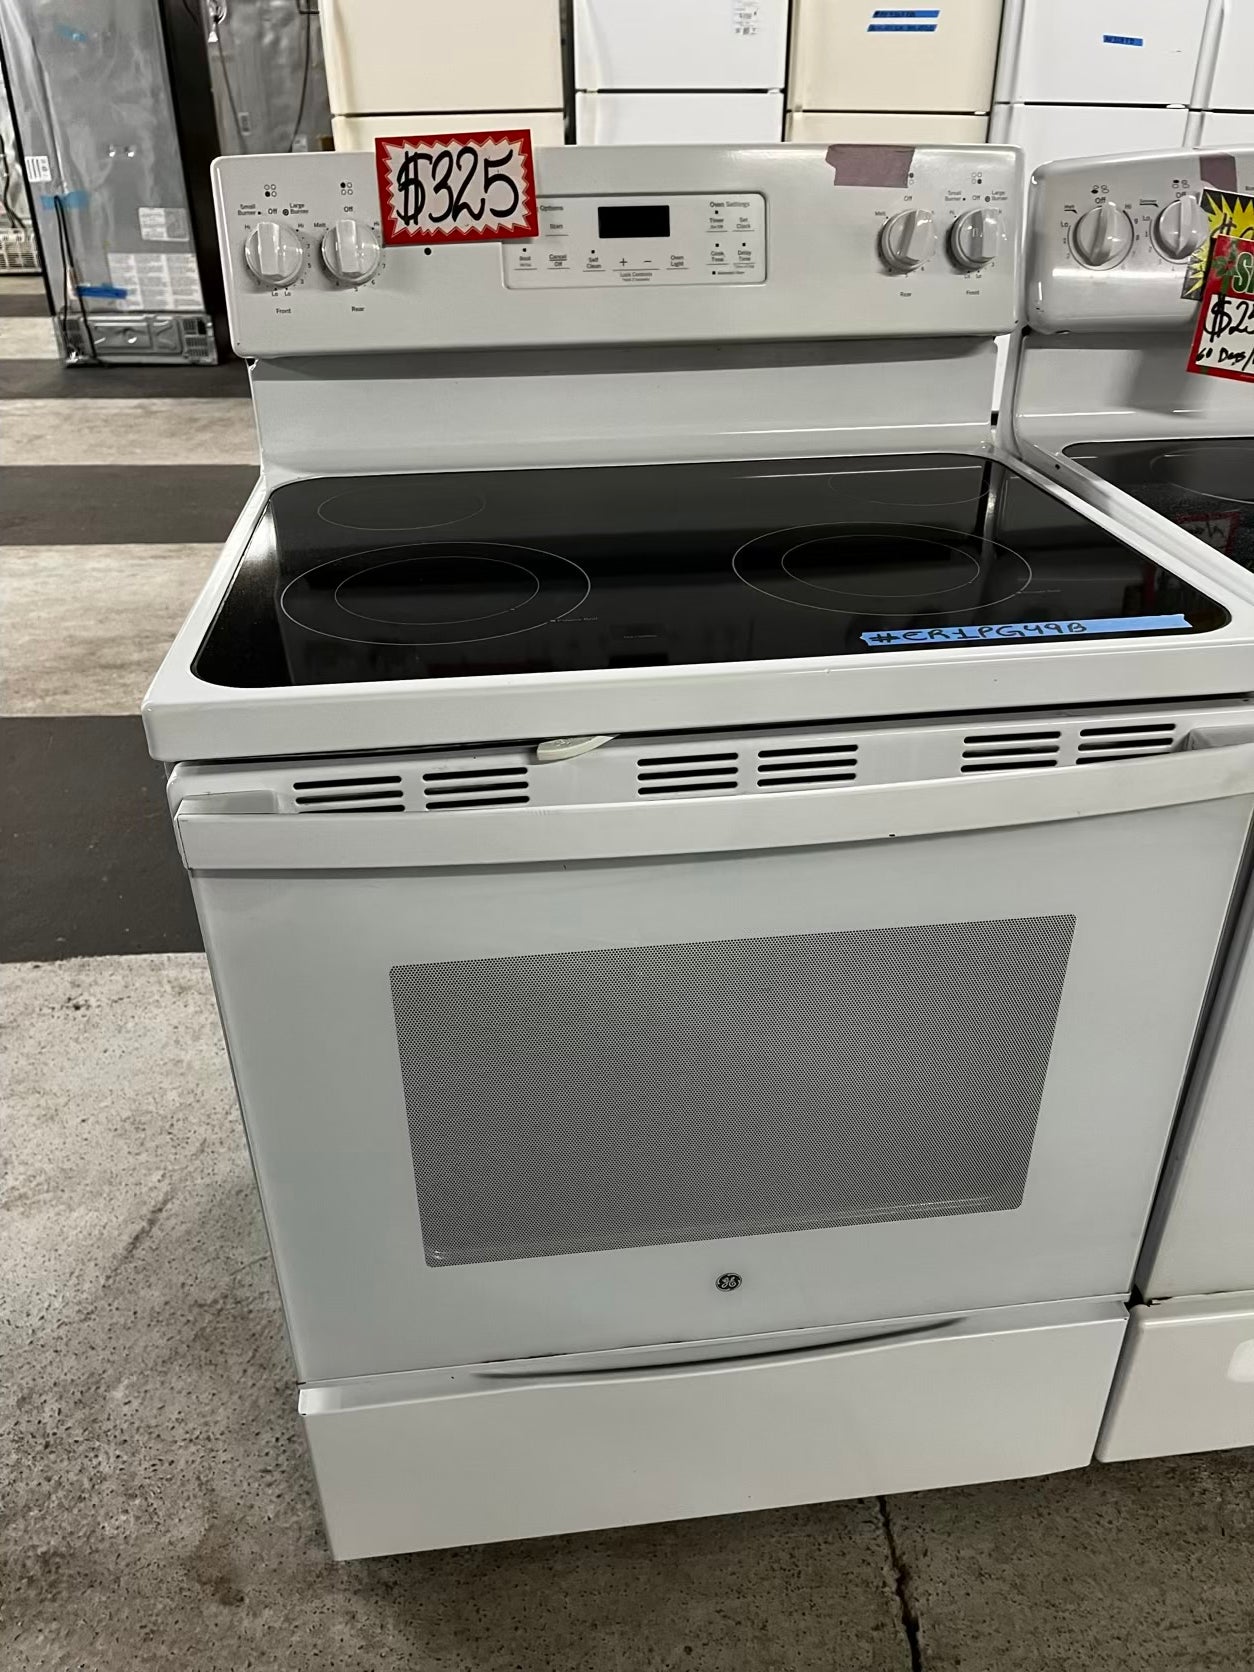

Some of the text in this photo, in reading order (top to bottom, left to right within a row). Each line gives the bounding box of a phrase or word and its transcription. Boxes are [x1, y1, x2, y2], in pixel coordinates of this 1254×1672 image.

[396, 145, 519, 226] $325
[267, 207, 278, 215] Off
[1231, 251, 1254, 294] S
